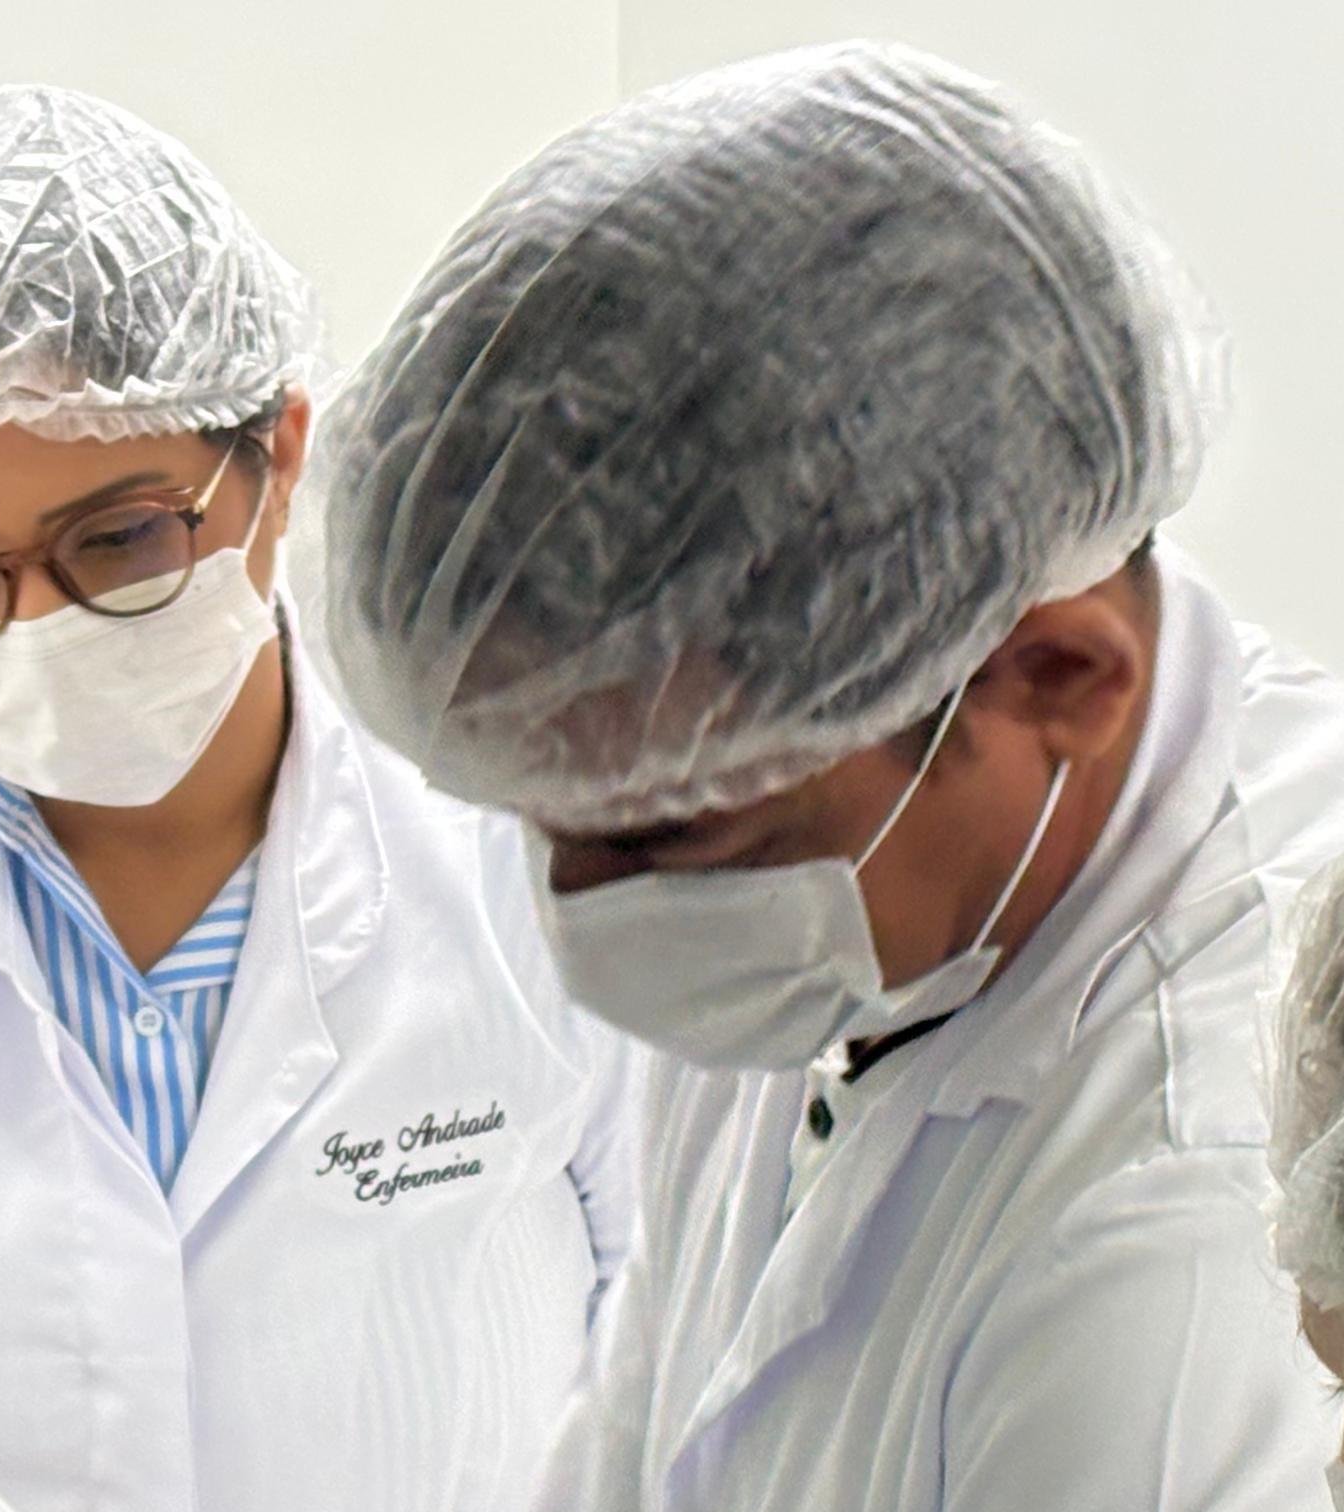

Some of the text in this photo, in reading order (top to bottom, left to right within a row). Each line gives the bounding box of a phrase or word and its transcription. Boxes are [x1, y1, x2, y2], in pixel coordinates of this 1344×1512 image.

[316, 1100, 505, 1176] Joyce Andrade
[354, 1152, 484, 1206] Enfermeira
